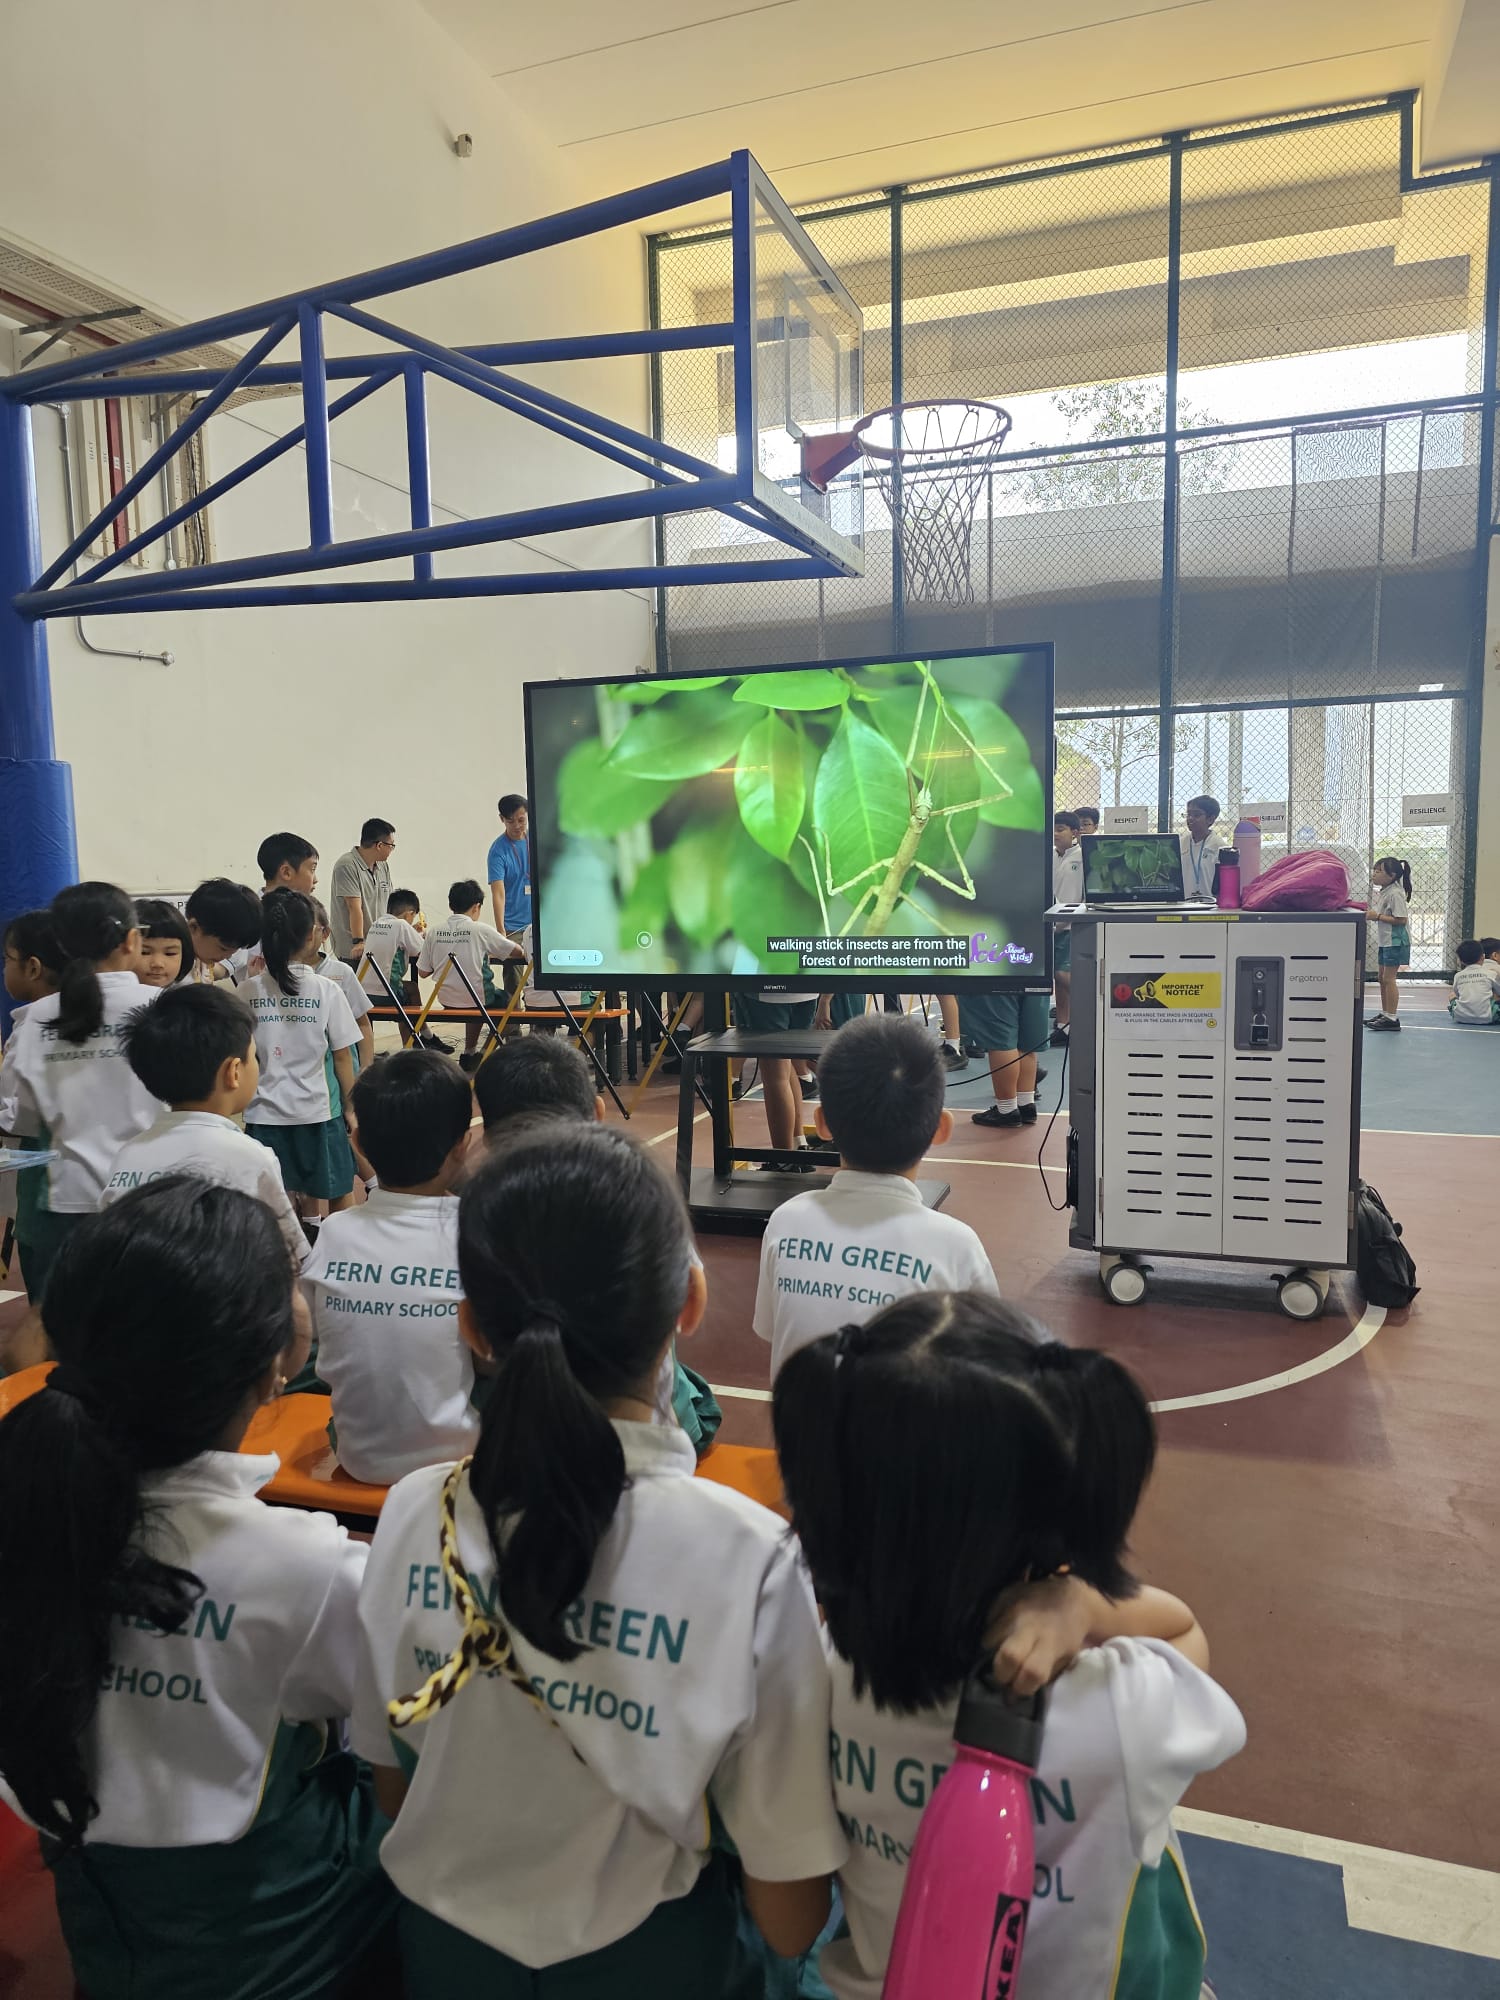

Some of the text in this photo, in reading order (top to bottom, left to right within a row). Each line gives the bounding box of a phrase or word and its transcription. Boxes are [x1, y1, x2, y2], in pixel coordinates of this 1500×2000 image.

[1409, 807, 1447, 815] RESILIENCE
[769, 938, 967, 953] walking stick insects are from the
[801, 954, 967, 966] forest of northeastern north
[1289, 975, 1328, 983] ergotron
[280, 998, 320, 1009] GREEN
[286, 1015, 317, 1023] SCHOOL
[109, 1172, 142, 1187] ERN
[778, 1238, 932, 1284] FERN GREEN
[324, 1261, 464, 1289] FERN GREE
[778, 1277, 895, 1307] PRIMARY SCHO
[325, 1295, 460, 1317] PRIMARY SCHOO
[562, 1597, 690, 1664] REEN
[529, 1676, 661, 1738] SCHOOL
